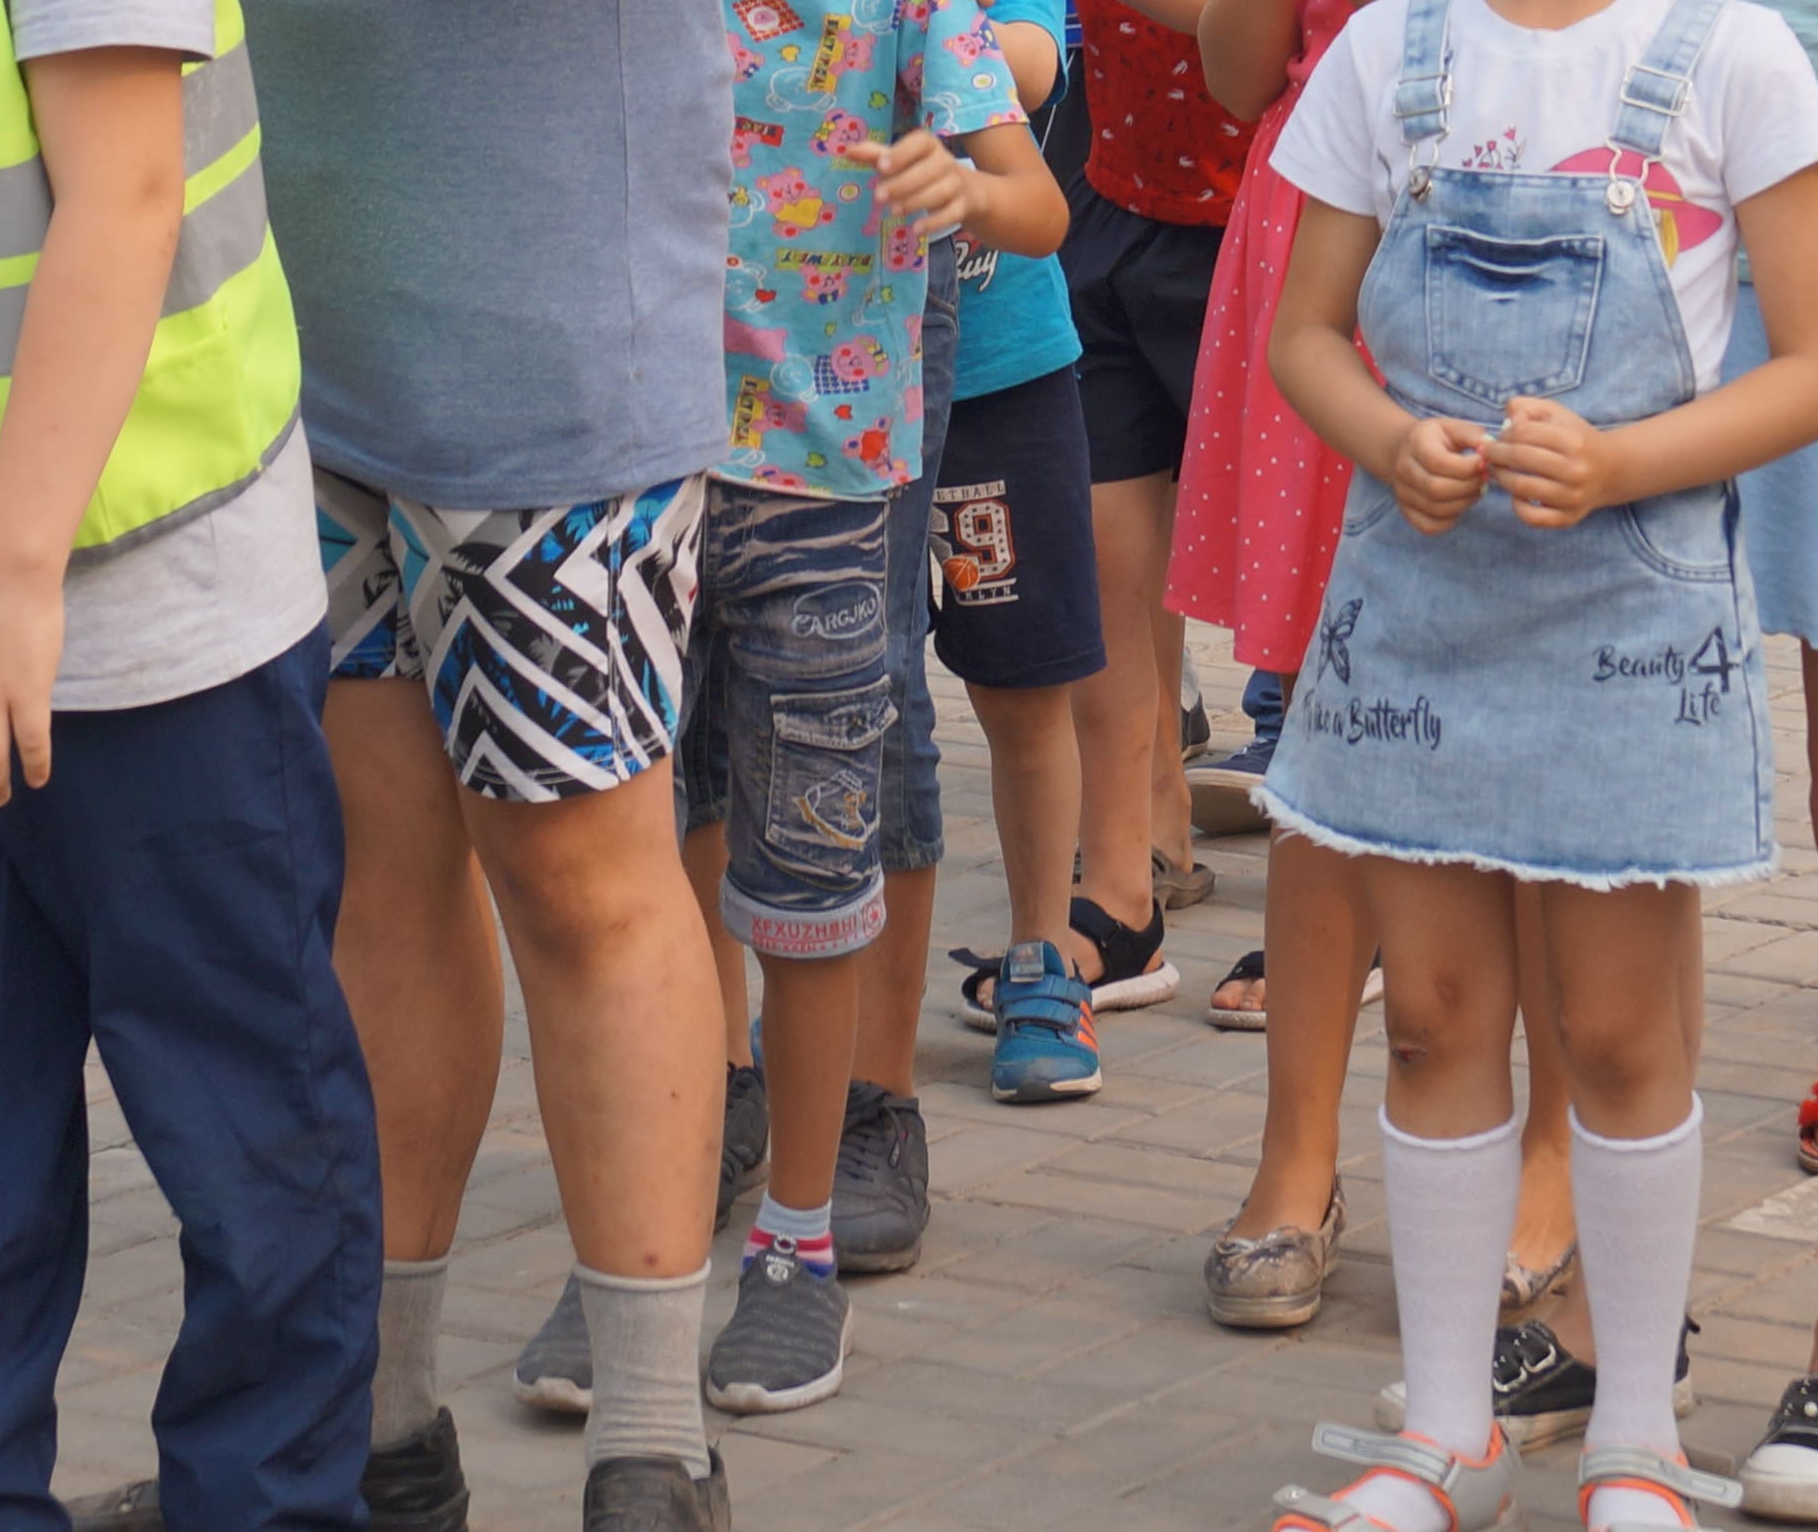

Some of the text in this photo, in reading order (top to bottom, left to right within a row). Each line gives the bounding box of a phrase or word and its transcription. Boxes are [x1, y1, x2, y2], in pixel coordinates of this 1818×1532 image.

[1592, 625, 1740, 694] Beauty 4
[1346, 694, 1442, 751] Butterfly
[1674, 681, 1721, 726] Life
